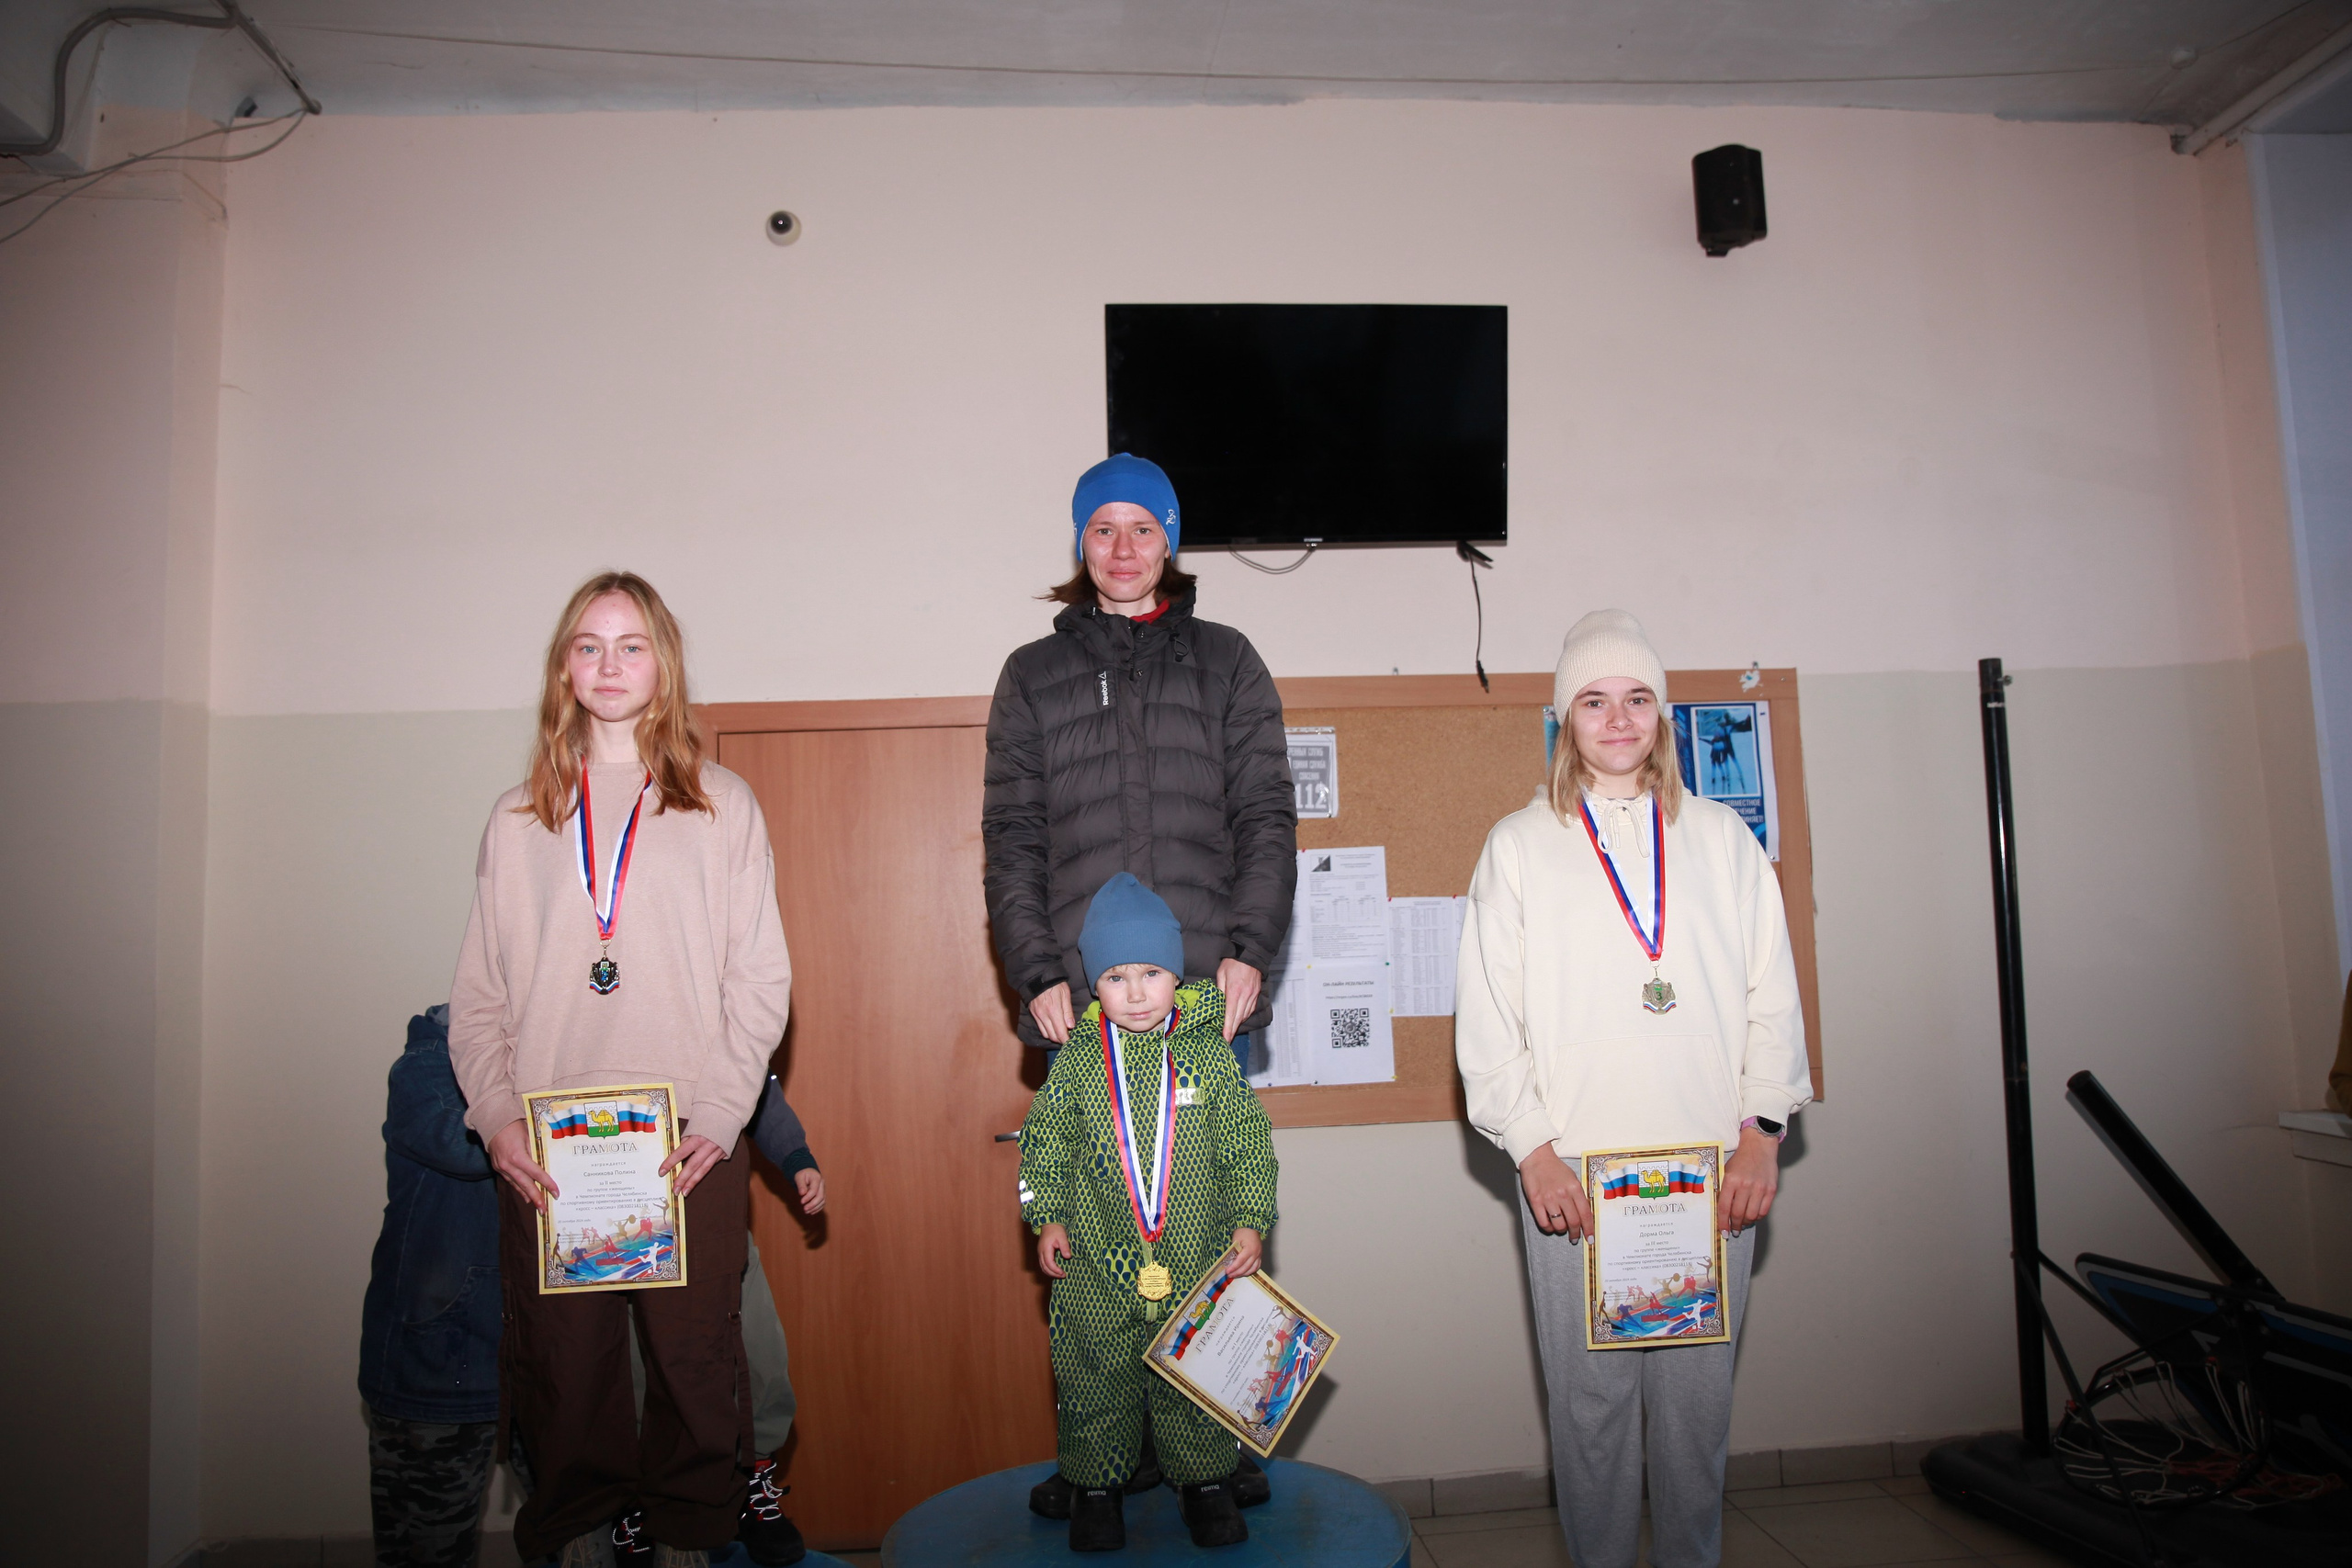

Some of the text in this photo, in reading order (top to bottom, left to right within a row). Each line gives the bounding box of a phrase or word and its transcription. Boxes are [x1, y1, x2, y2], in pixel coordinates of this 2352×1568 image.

[1101, 680, 1109, 705] Reebok
[1295, 783, 1328, 808] 112
[1656, 991, 1663, 1000] 3
[572, 1142, 639, 1156] ГРАМОТА
[1623, 1202, 1687, 1216] ГРАМОТА
[1195, 1297, 1235, 1352] ГРАМОТА
[1216, 1315, 1245, 1356] Васильева Ирина
[1201, 1483, 1220, 1492] reima
